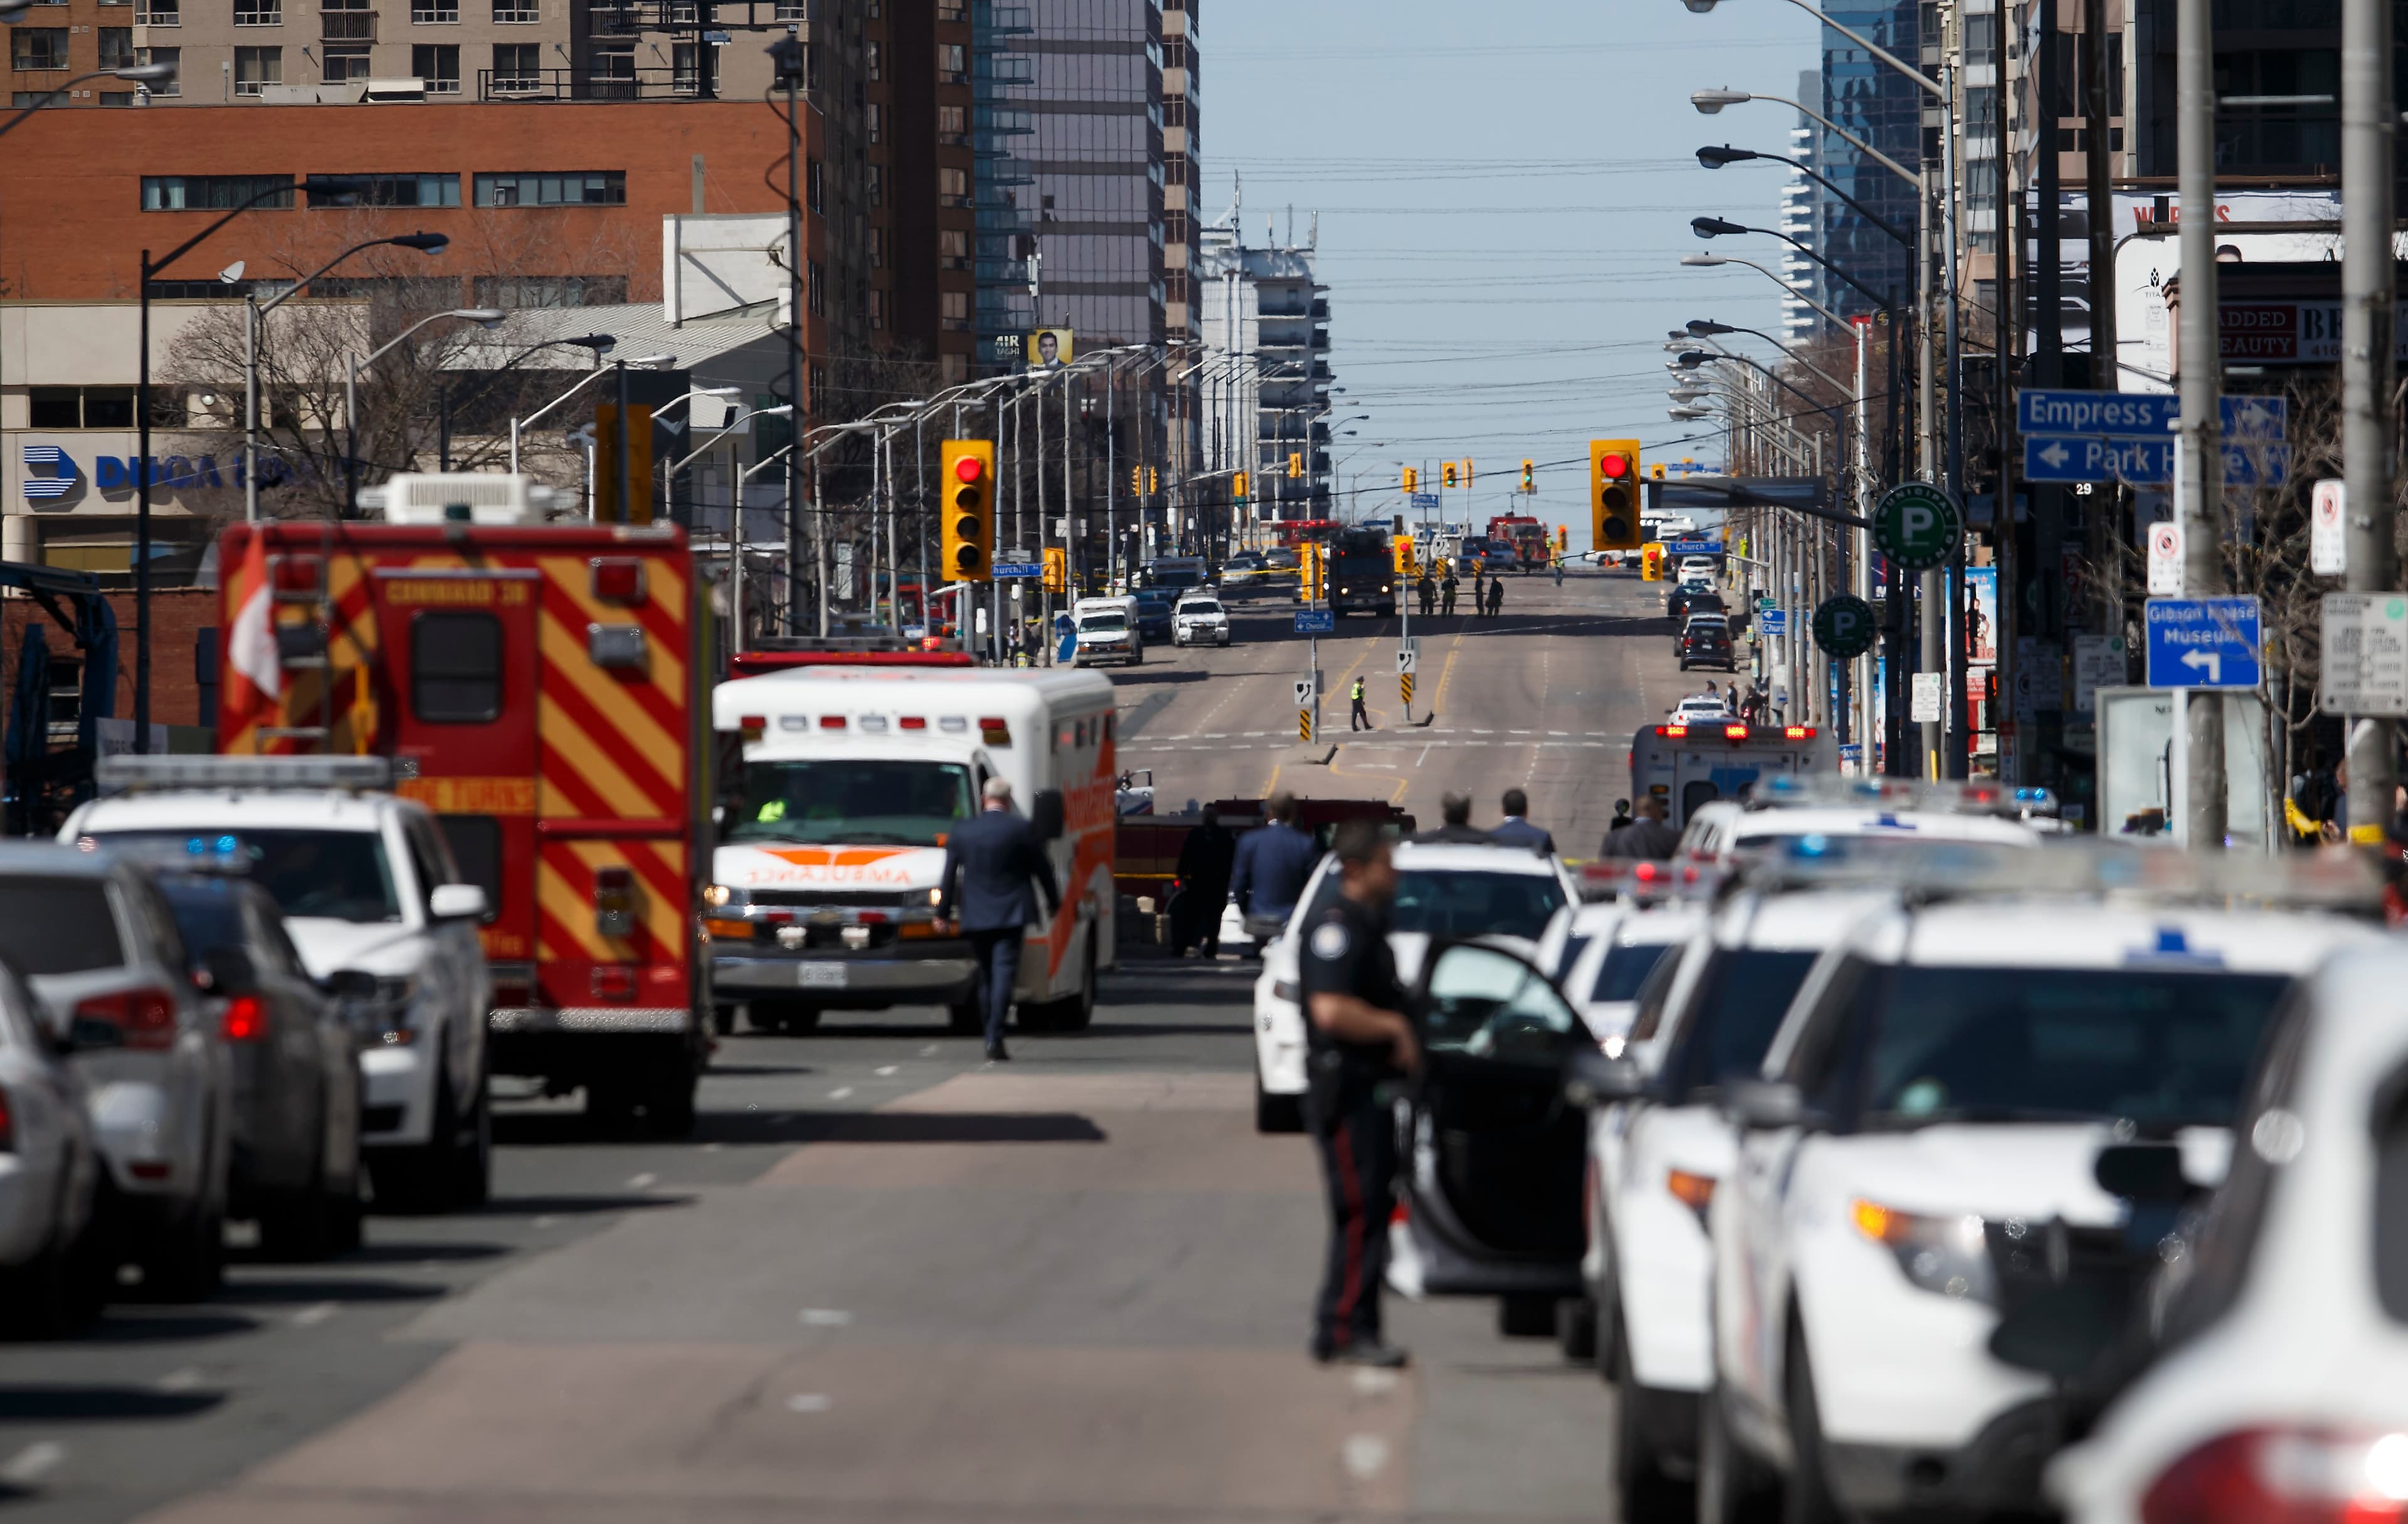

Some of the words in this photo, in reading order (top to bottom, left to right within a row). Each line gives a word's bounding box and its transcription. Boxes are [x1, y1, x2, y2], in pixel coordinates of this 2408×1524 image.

[2219, 337, 2292, 354] EAUTY
[2030, 394, 2152, 430] Empress
[2162, 400, 2180, 414] Av
[2086, 443, 2150, 472] Park
[2076, 483, 2093, 495] 29
[1902, 507, 1934, 539] P
[1676, 542, 1706, 550] Church
[993, 565, 1028, 574] hurchill
[2148, 605, 2205, 623] Gibson
